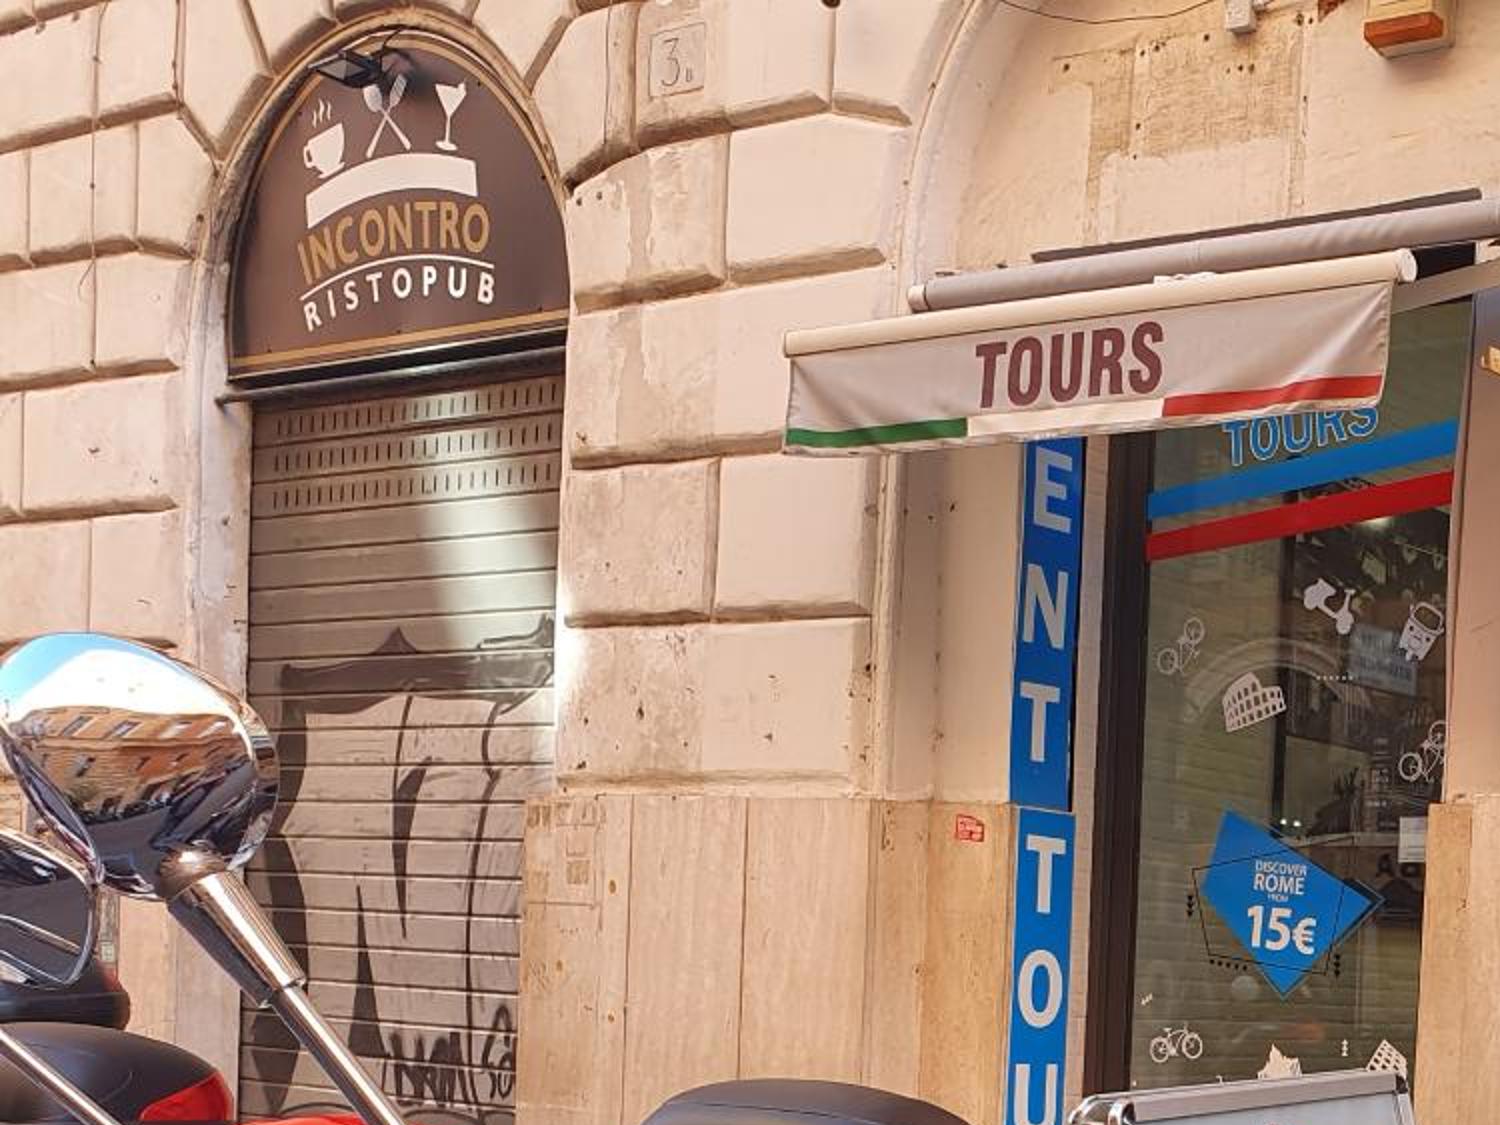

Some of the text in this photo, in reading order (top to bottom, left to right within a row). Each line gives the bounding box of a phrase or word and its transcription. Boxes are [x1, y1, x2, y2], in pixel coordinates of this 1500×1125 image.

[297, 200, 490, 285] INCONTRO
[302, 265, 495, 332] RISTOPUB
[974, 319, 1165, 409] TOURS
[1221, 406, 1379, 467] TOURS
[1253, 872, 1306, 896] ROME
[1255, 859, 1308, 877] DISCOVER
[1247, 904, 1317, 955] 15€
